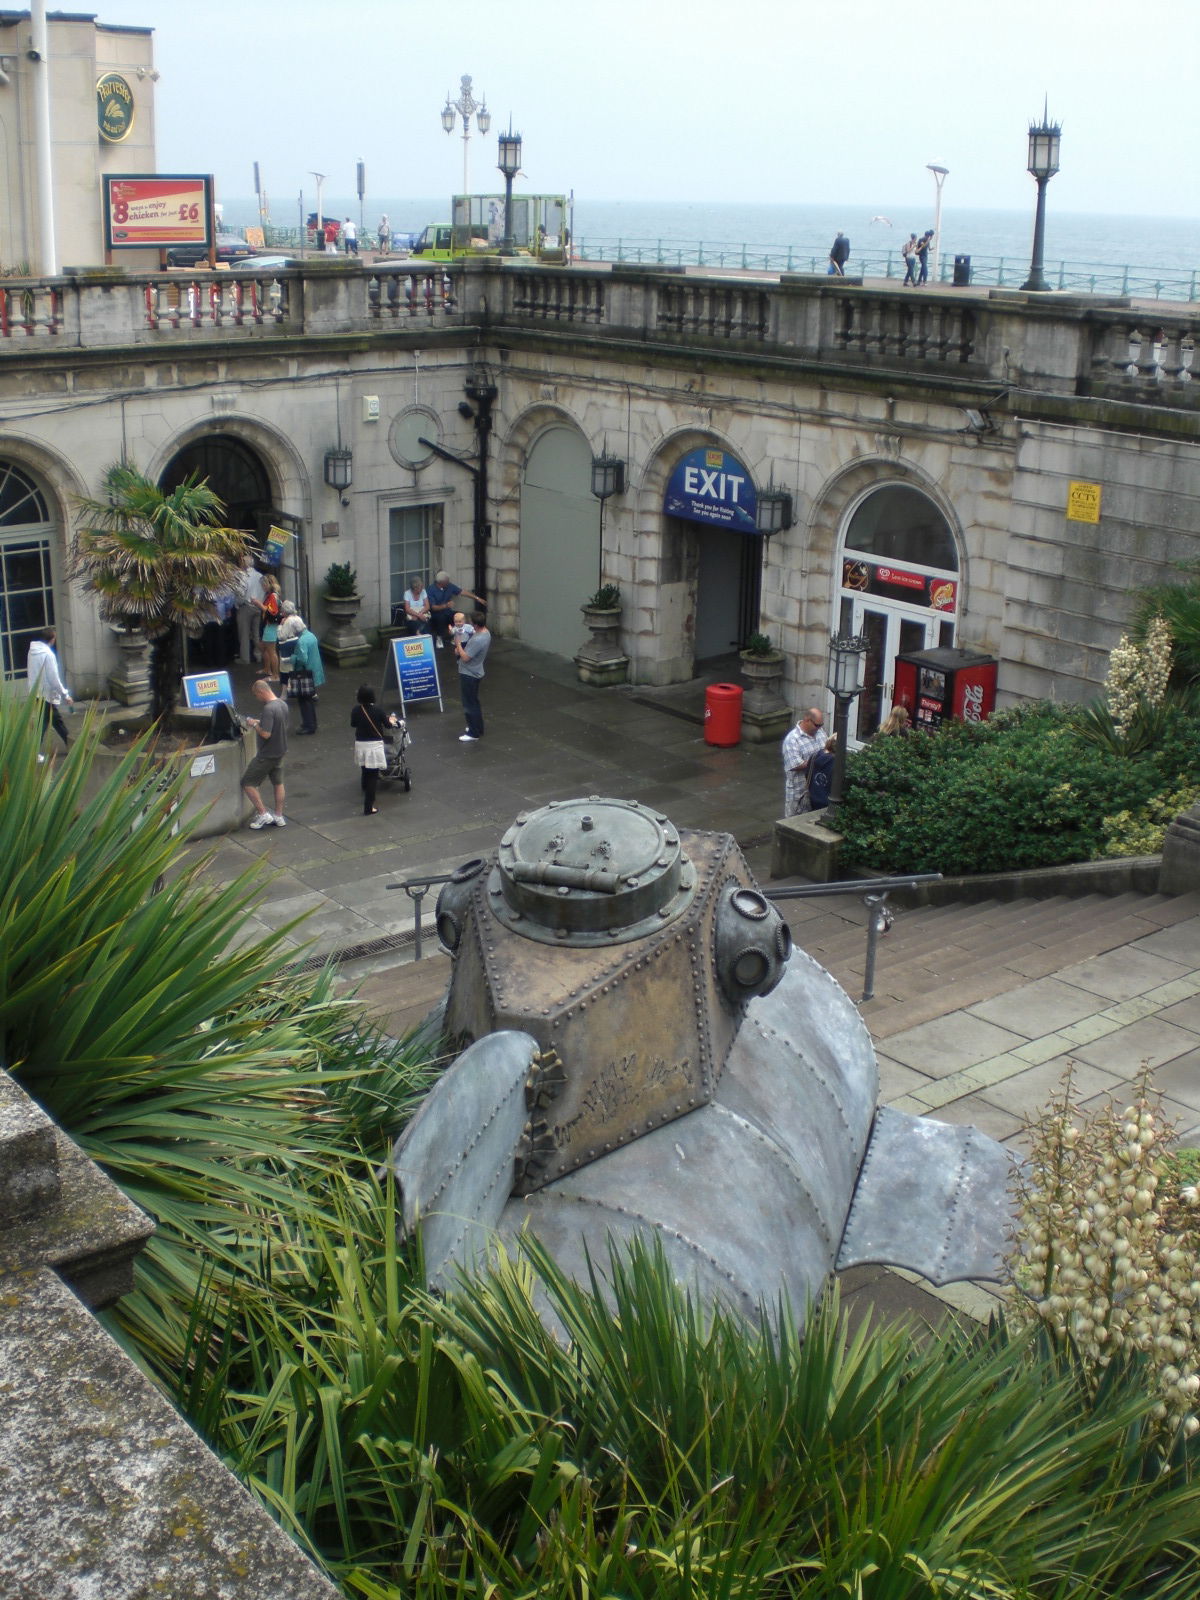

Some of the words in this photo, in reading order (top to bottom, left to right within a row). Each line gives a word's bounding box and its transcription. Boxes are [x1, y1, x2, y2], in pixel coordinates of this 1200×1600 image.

[97, 82, 131, 104] Harvester
[149, 201, 167, 209] enjoy
[178, 202, 200, 221] £6
[113, 201, 129, 224] 8
[129, 210, 159, 220] chicken
[684, 466, 745, 503] EXIT
[1072, 491, 1098, 502] CCTV
[691, 500, 704, 509] Thank
[709, 511, 721, 519] again
[921, 698, 942, 711] Thirsty?
[963, 684, 984, 723] Cola
